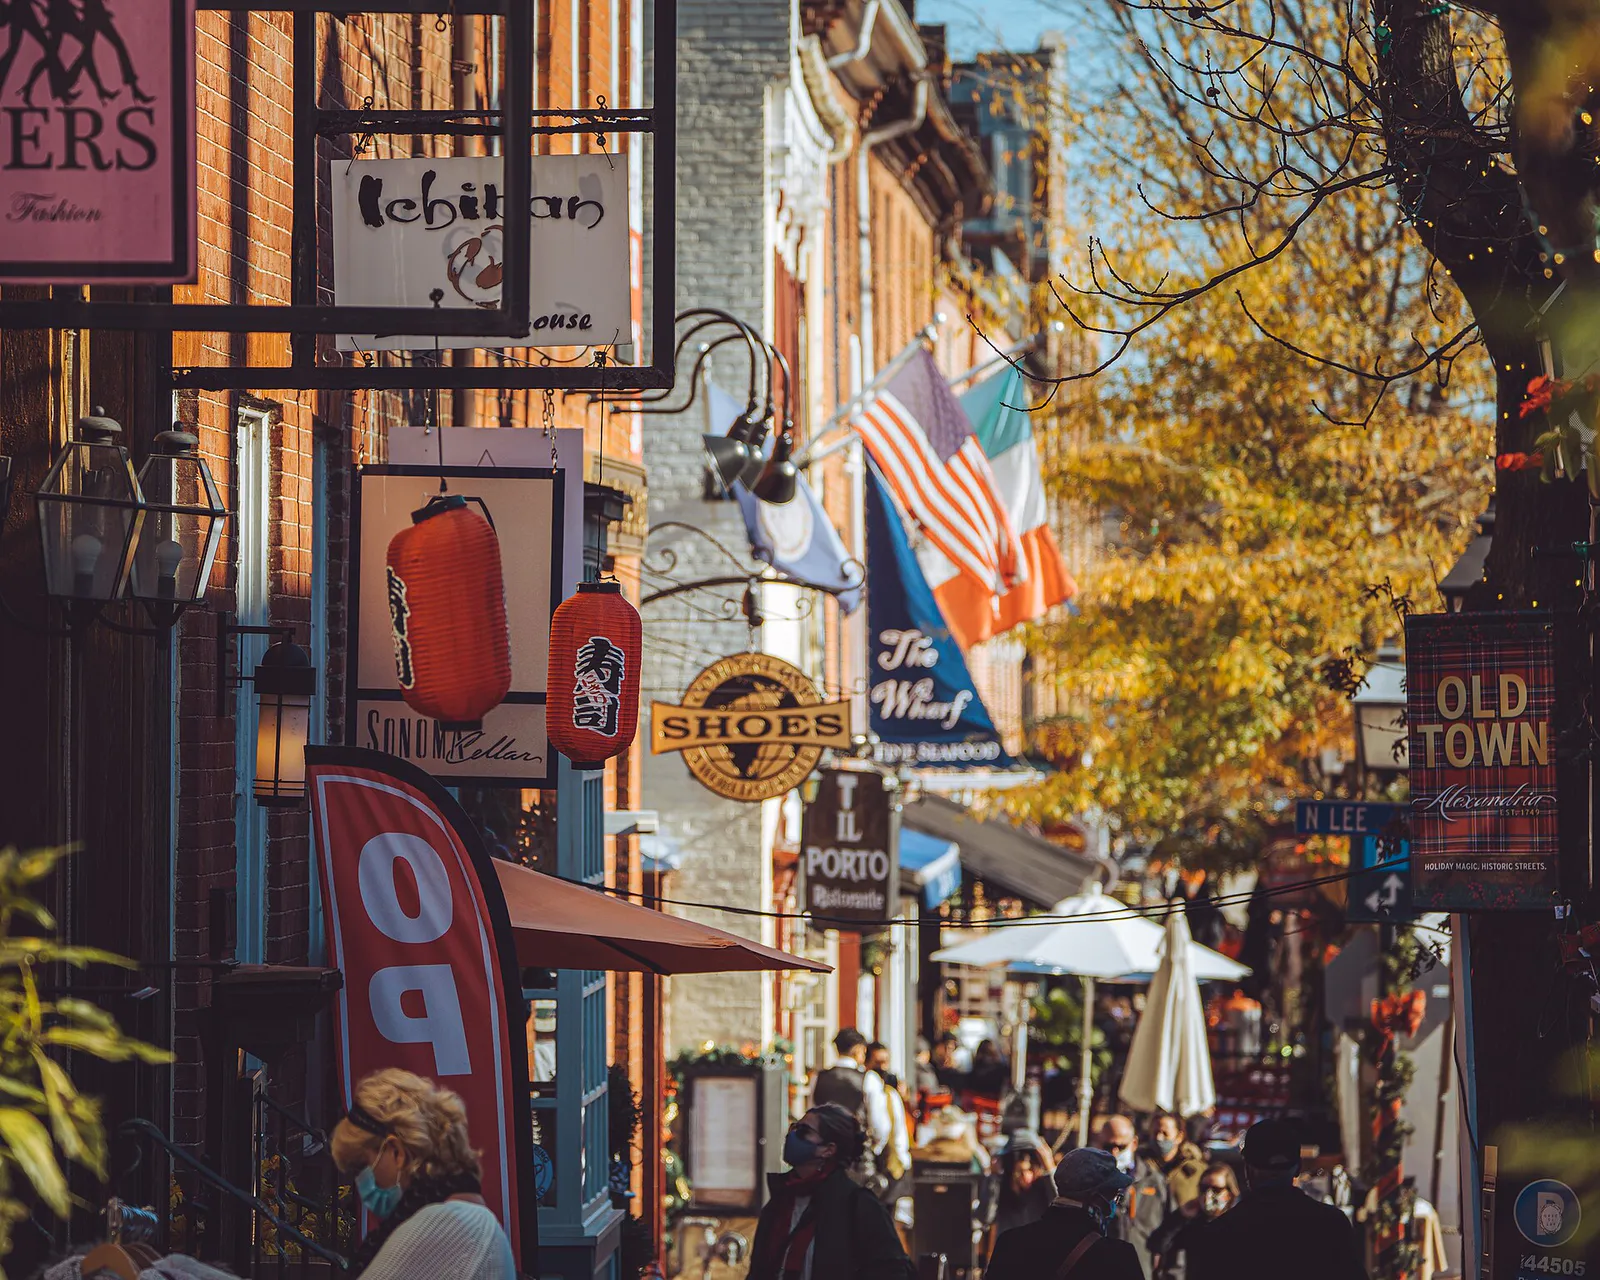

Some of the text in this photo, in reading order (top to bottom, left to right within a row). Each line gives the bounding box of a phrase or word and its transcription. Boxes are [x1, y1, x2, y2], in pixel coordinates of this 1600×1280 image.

[5, 191, 105, 224] Fashion
[528, 312, 593, 331] ouse
[877, 628, 939, 671] The
[871, 677, 974, 731] Wharf
[1436, 674, 1528, 720] OLD
[662, 714, 844, 740] SHOES
[445, 731, 543, 764] Cellar
[1416, 721, 1549, 768] TOWN
[1305, 805, 1368, 832] N LEE
[1411, 782, 1557, 822] Alexandria
[836, 810, 863, 842] IL
[806, 846, 889, 882] PORTO
[1424, 862, 1547, 871] HOLIDAY MAGIC. HISTORIC STREETS.
